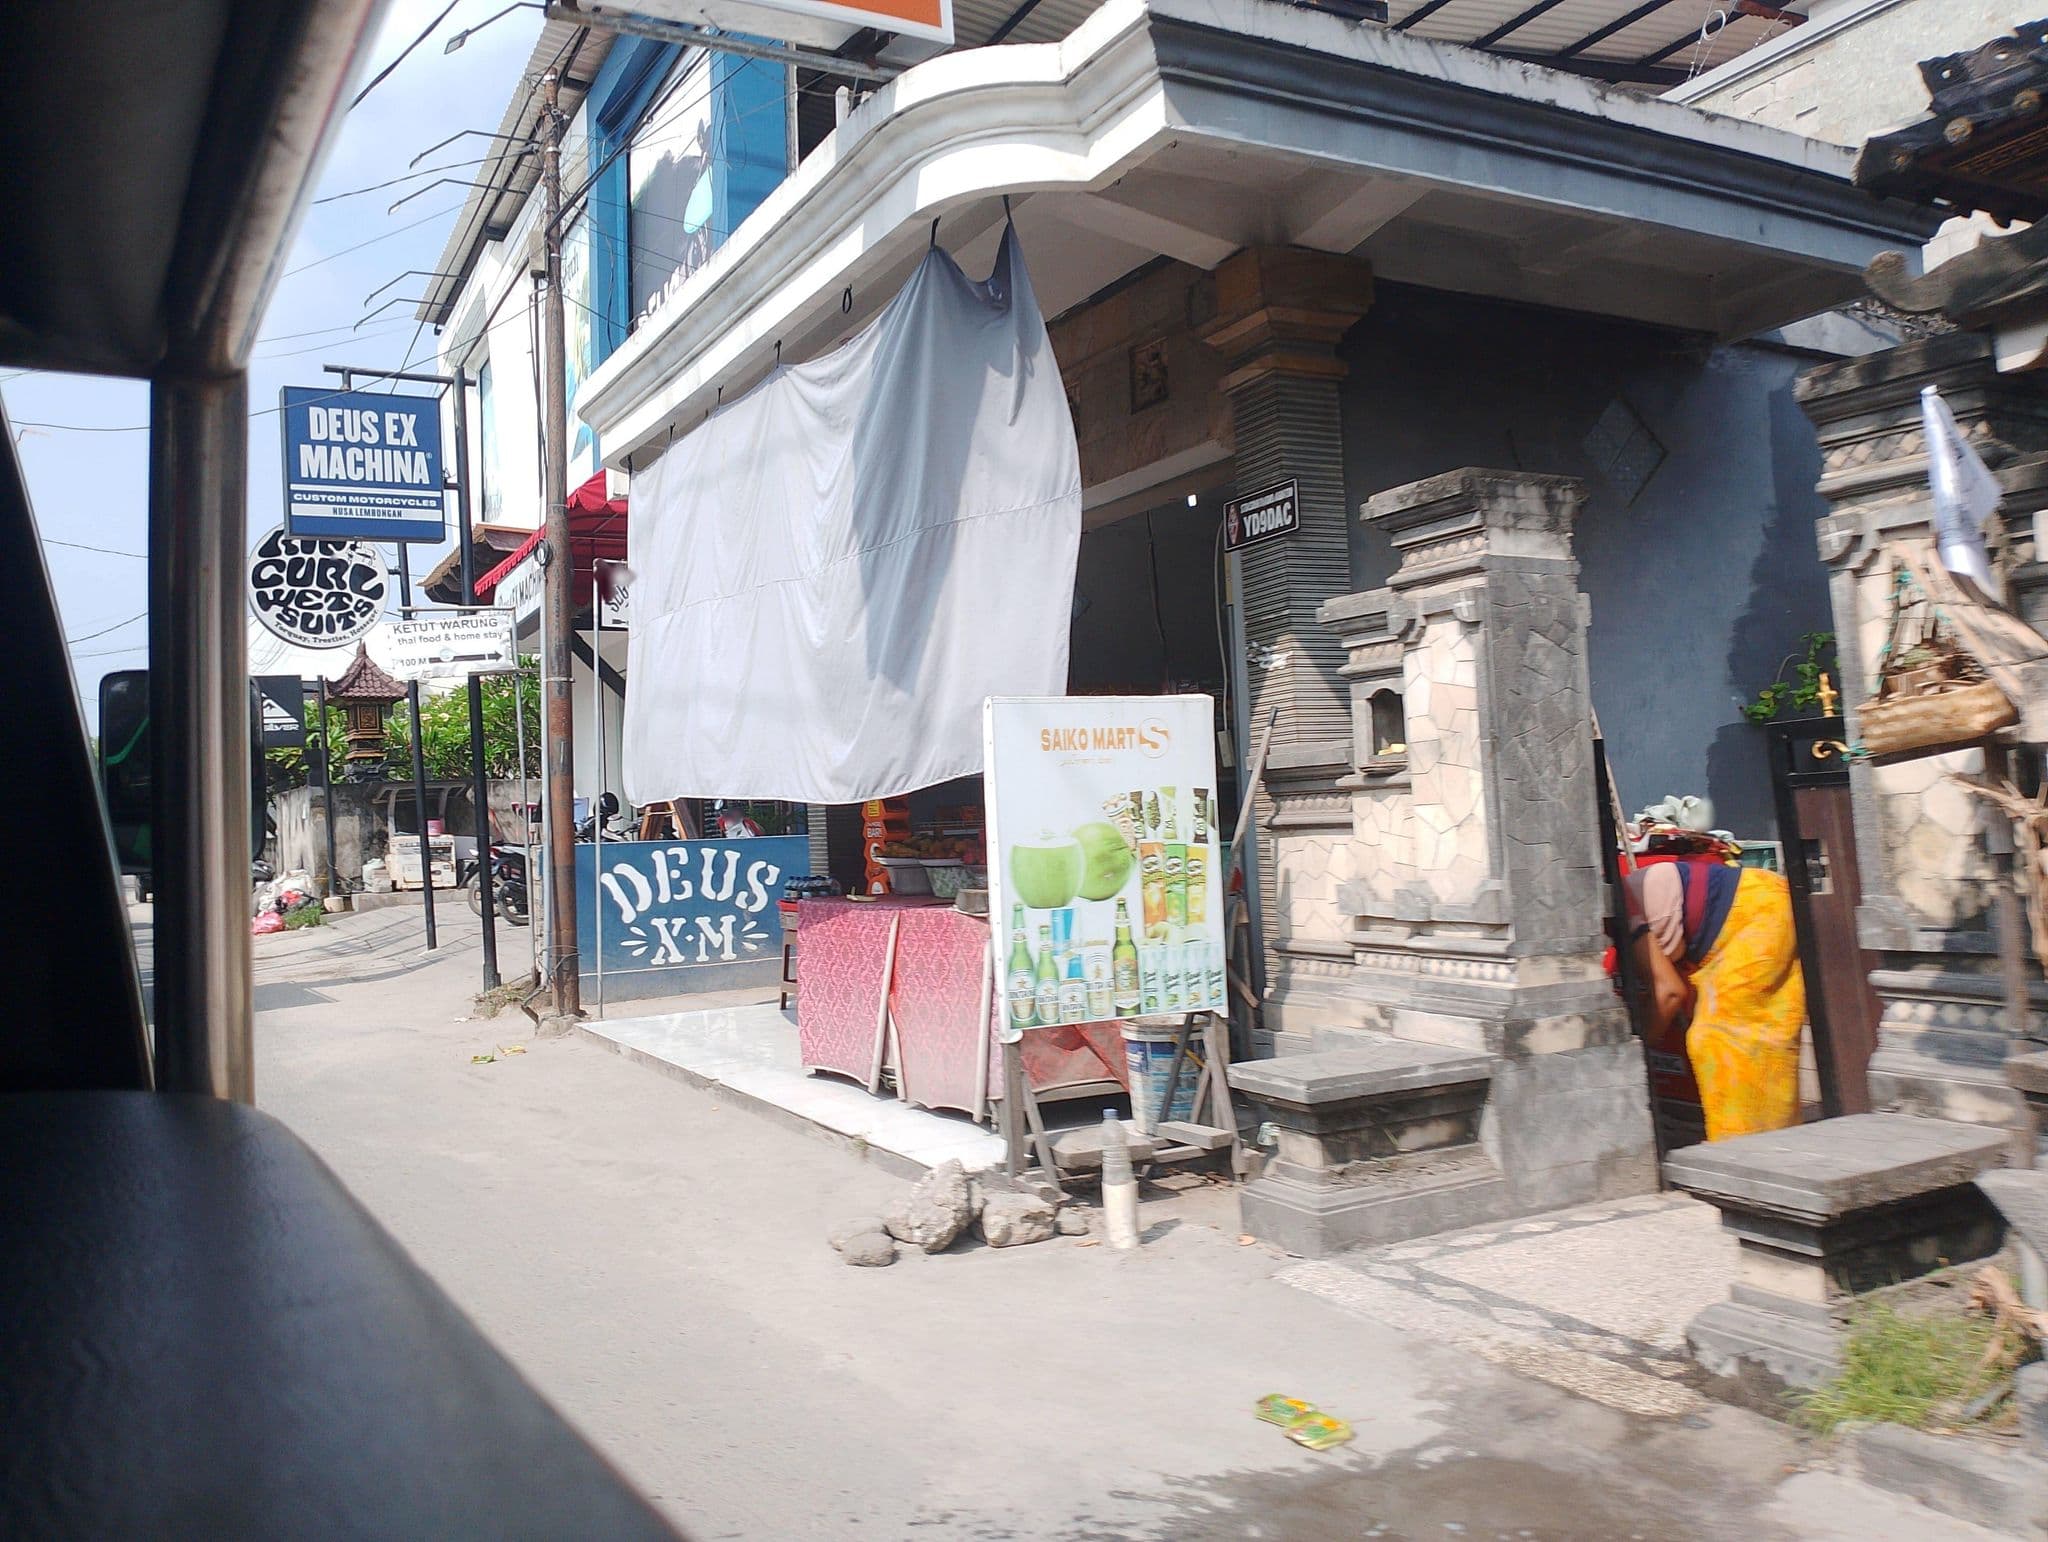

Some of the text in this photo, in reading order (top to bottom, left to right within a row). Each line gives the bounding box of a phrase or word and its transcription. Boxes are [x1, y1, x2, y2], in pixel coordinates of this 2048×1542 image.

[308, 406, 418, 447] DEUS EX
[299, 443, 431, 485] MACHINA
[293, 493, 438, 507] CUSTOM MOTORCYCLES
[332, 506, 403, 518] NUSA LEMBONGAN
[1242, 500, 1294, 538] YD9DAC
[251, 556, 385, 601] CURL
[255, 588, 354, 612] WET
[275, 598, 375, 635] SUITS
[392, 617, 498, 635] KETUT WARUNG
[419, 633, 441, 643] food
[444, 632, 452, 642] &
[454, 632, 481, 641] home
[482, 630, 503, 641] stay
[400, 657, 417, 668] 100
[1041, 727, 1089, 752] SAIKO
[1092, 727, 1137, 750] MART
[599, 845, 781, 924] DEUS
